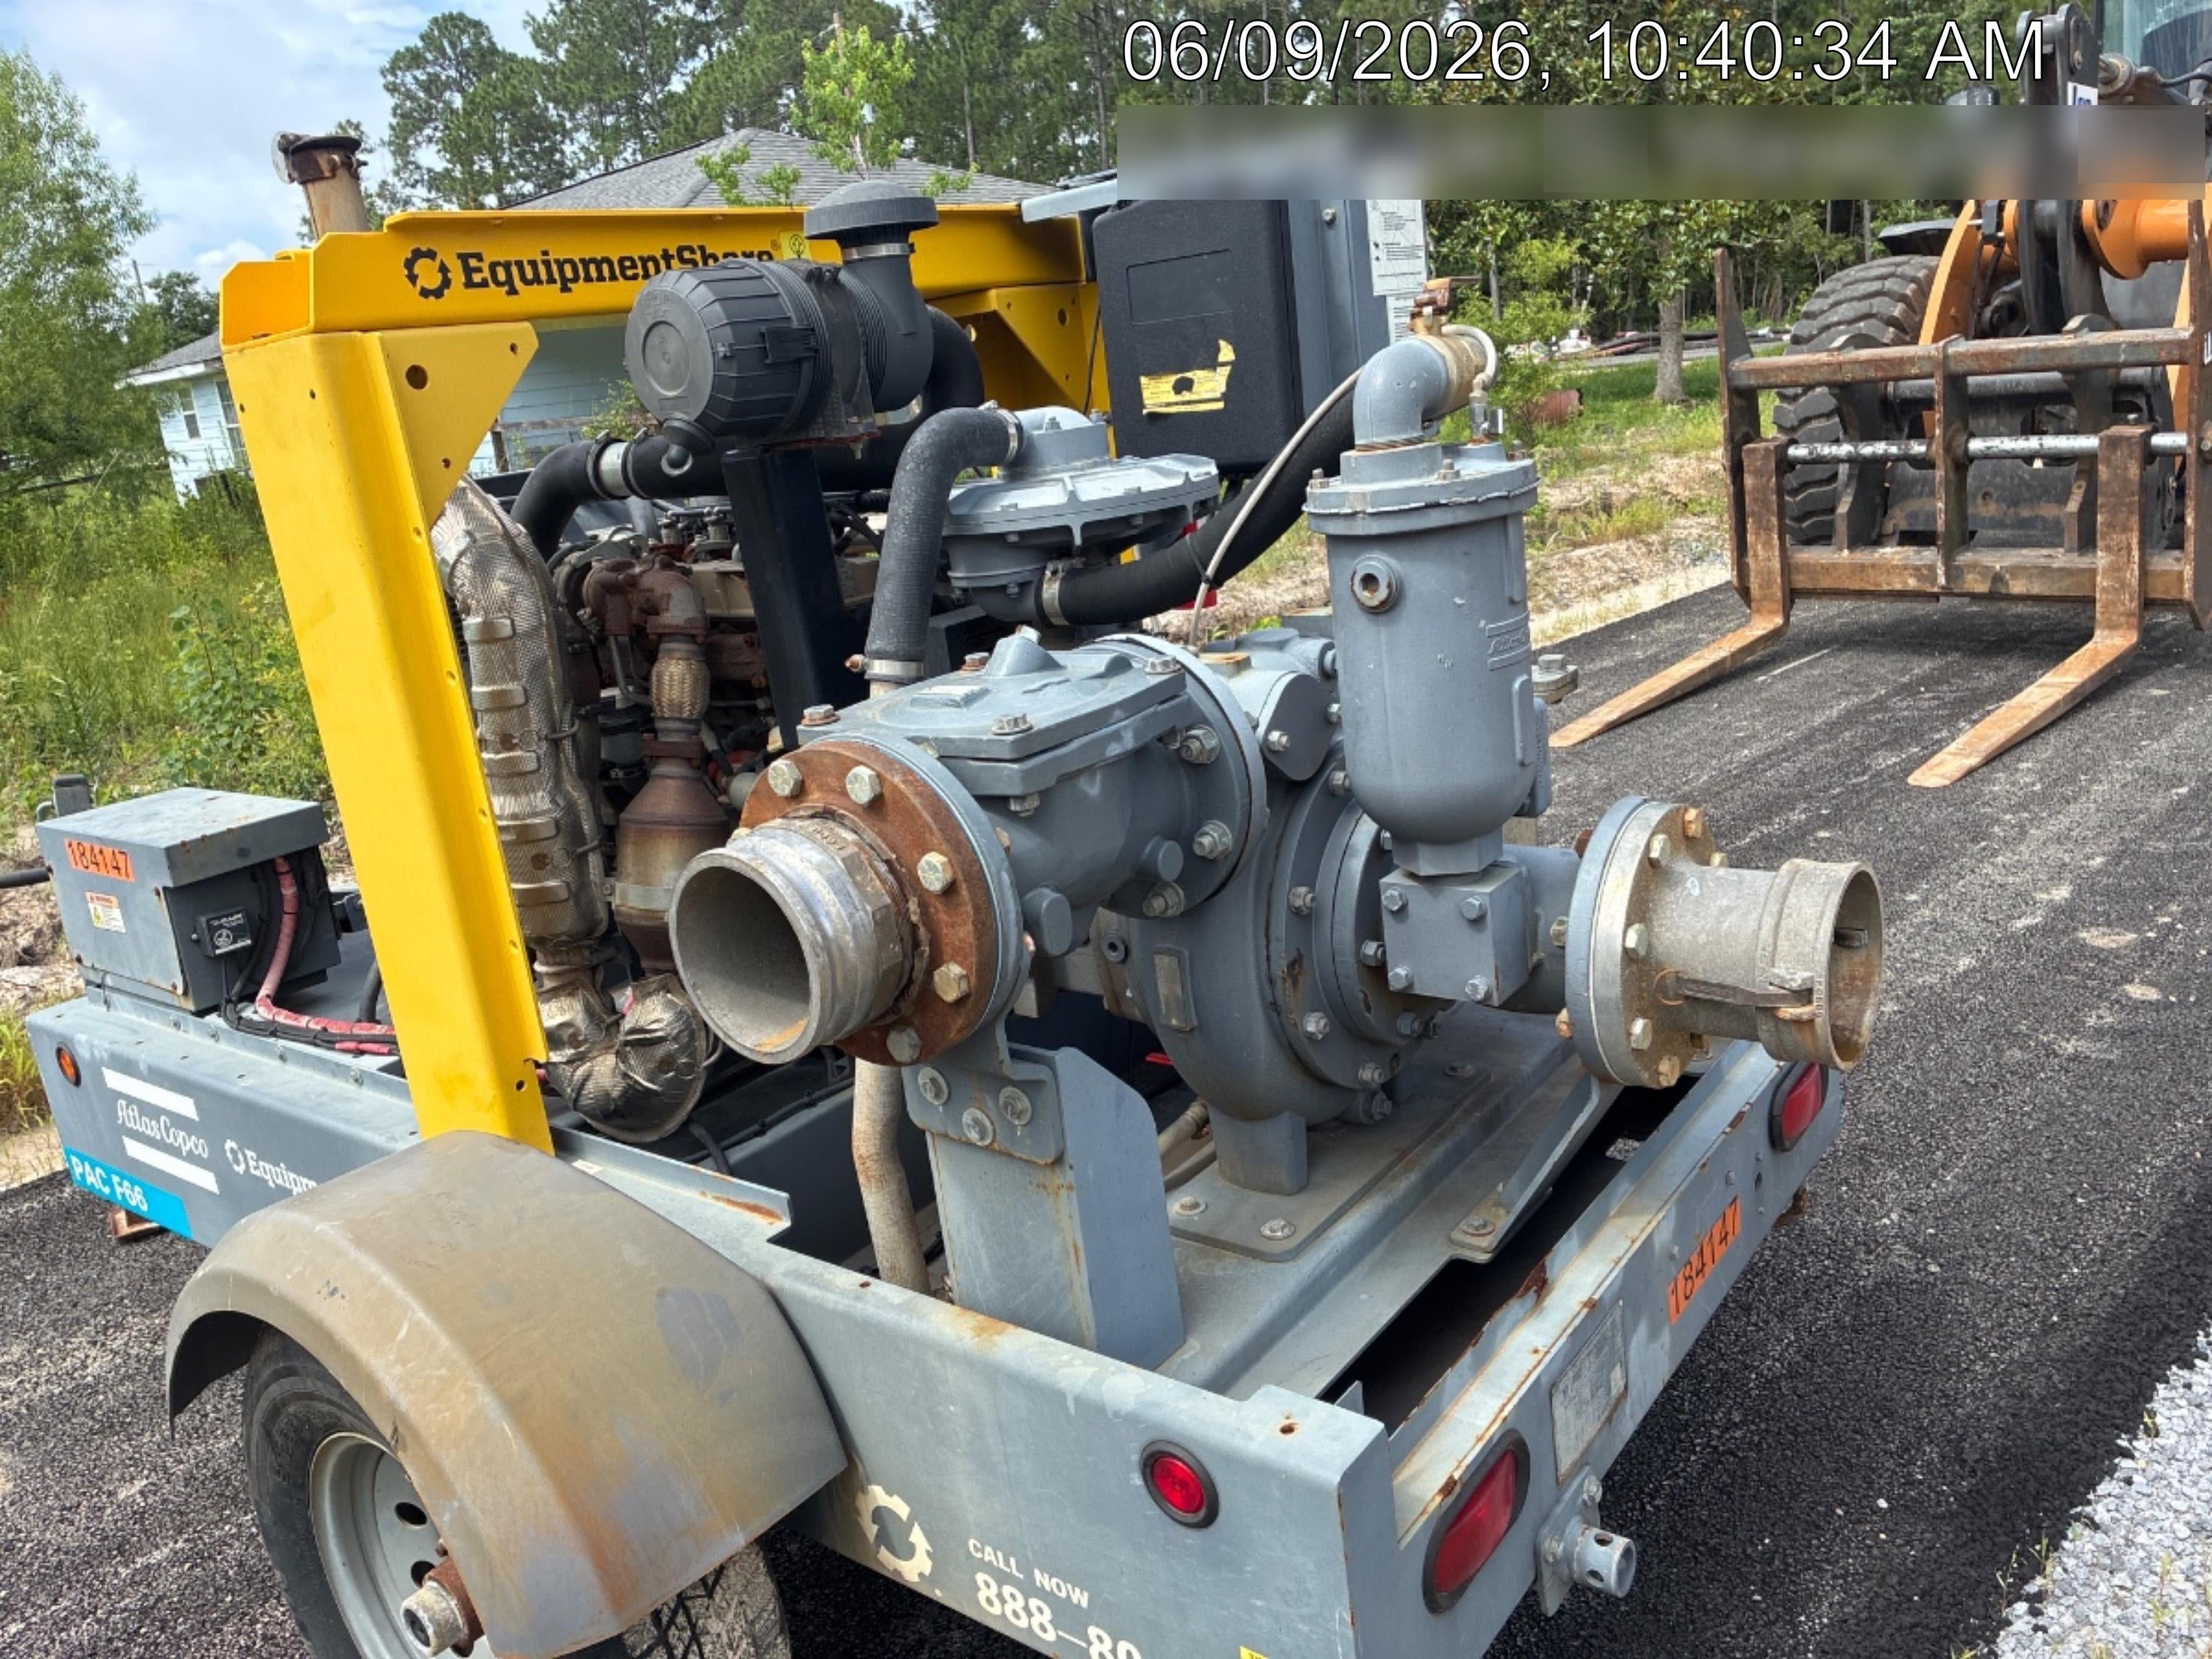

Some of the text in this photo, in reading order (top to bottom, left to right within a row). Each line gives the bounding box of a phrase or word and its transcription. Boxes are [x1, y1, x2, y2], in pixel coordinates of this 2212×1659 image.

[456, 244, 774, 296] EquipmentSh
[67, 839, 130, 879] 184147
[69, 1154, 149, 1212] PAC F66
[1671, 1194, 1739, 1315] 184147
[968, 1538, 1089, 1609] CALL NOW
